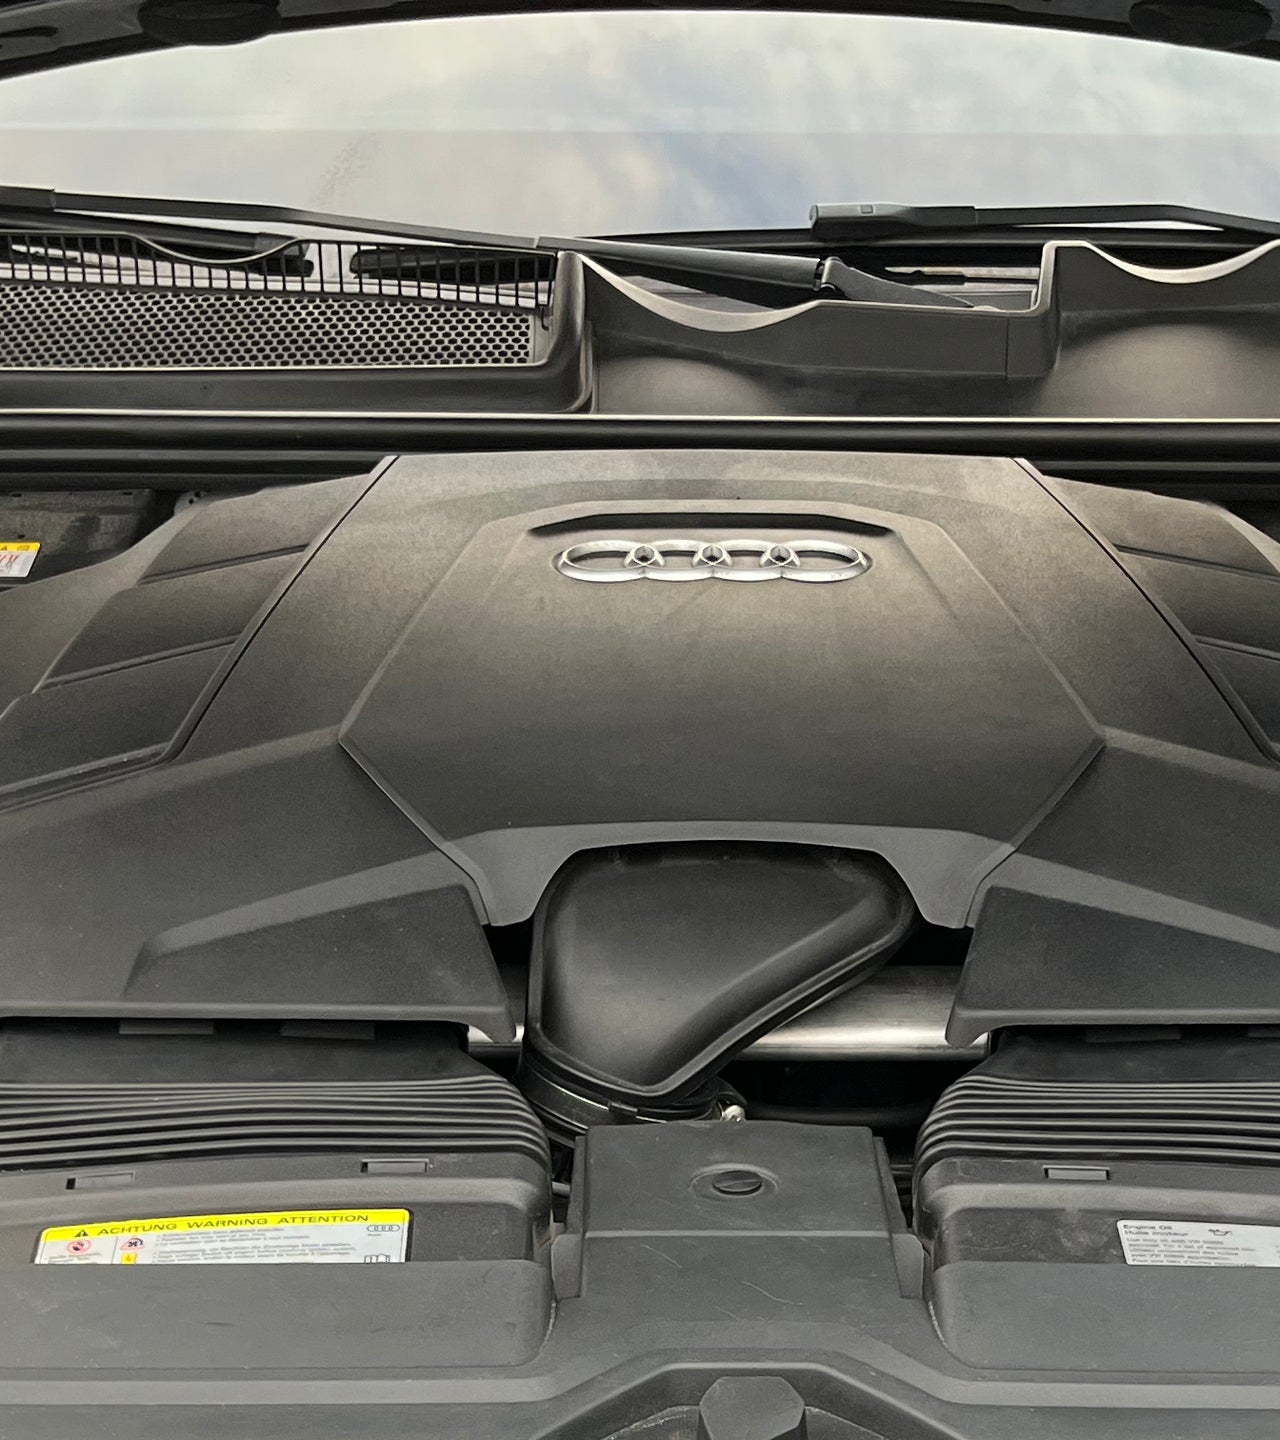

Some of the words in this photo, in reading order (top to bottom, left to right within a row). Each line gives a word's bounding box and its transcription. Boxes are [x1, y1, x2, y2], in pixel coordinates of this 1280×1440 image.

[96, 1222, 178, 1236] ACHTUNG
[187, 1217, 269, 1230] WARNING
[277, 1214, 369, 1225] ATTENTION
